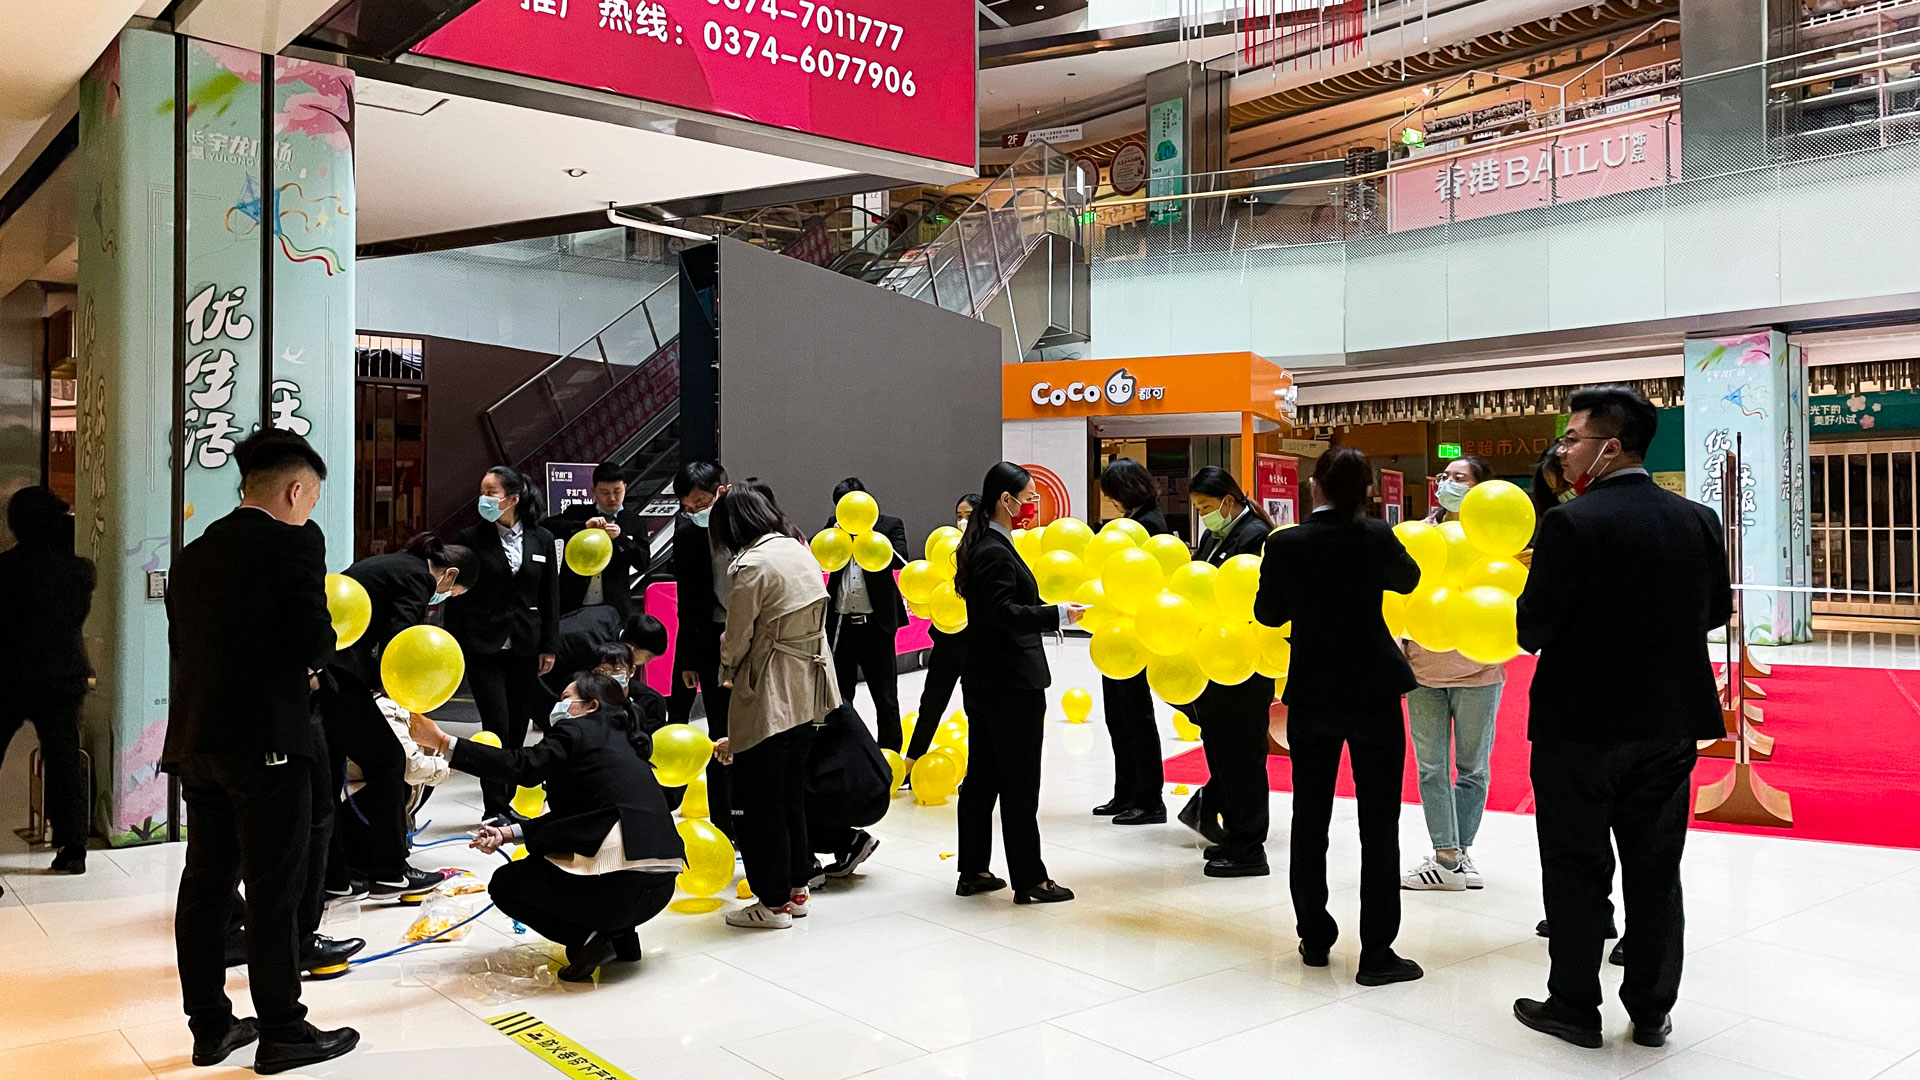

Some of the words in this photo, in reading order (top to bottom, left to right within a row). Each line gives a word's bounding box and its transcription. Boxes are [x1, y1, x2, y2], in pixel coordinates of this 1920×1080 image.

[706, 0, 904, 51] 4-7011777
[703, 20, 917, 97] 0374-6077906
[208, 132, 293, 162] 宇龙场
[1007, 134, 1019, 146] 2F
[1138, 387, 1166, 401] 都可
